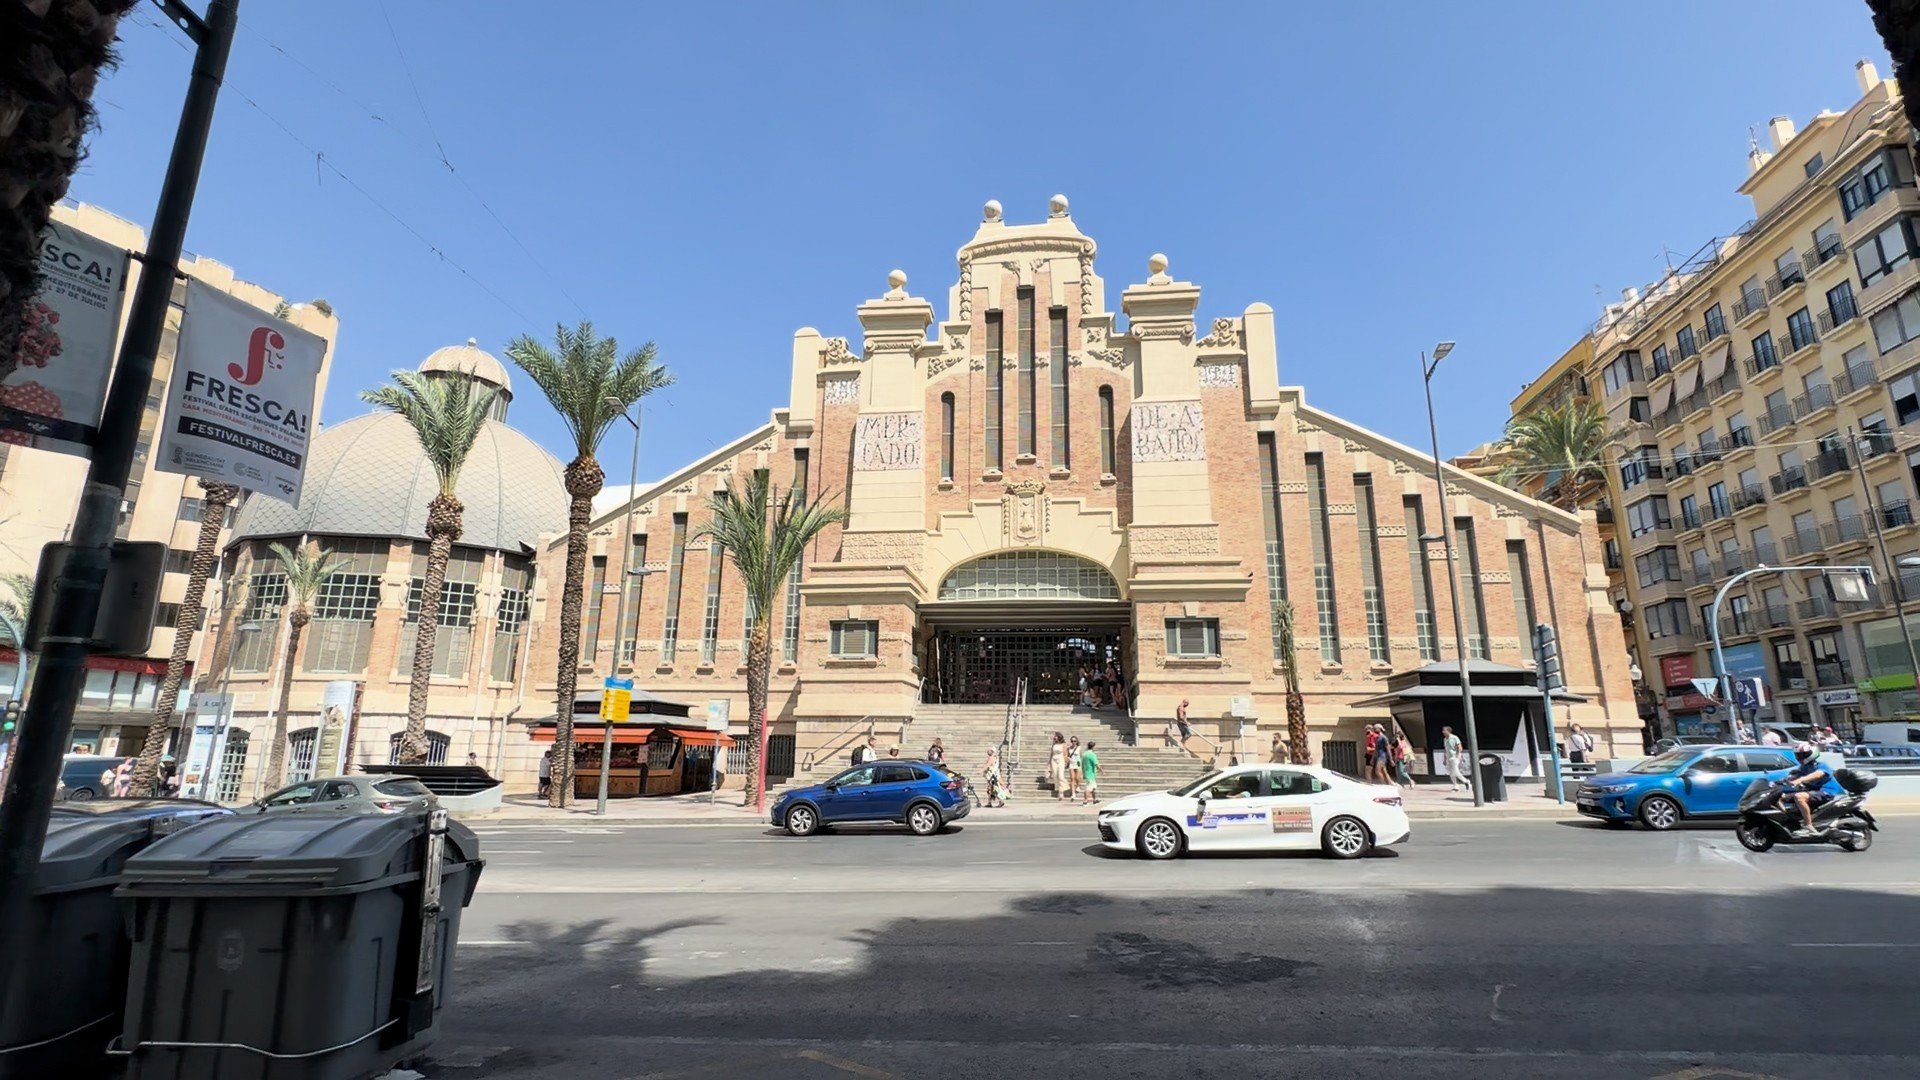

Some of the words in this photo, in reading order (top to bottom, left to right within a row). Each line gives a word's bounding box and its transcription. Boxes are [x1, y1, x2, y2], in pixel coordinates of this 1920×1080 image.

[44, 243, 112, 283] SCA!
[182, 394, 217, 409] FESTIVAL
[185, 371, 307, 433] FRESCA!
[189, 421, 297, 465] FESTIVALFRESCA.ES
